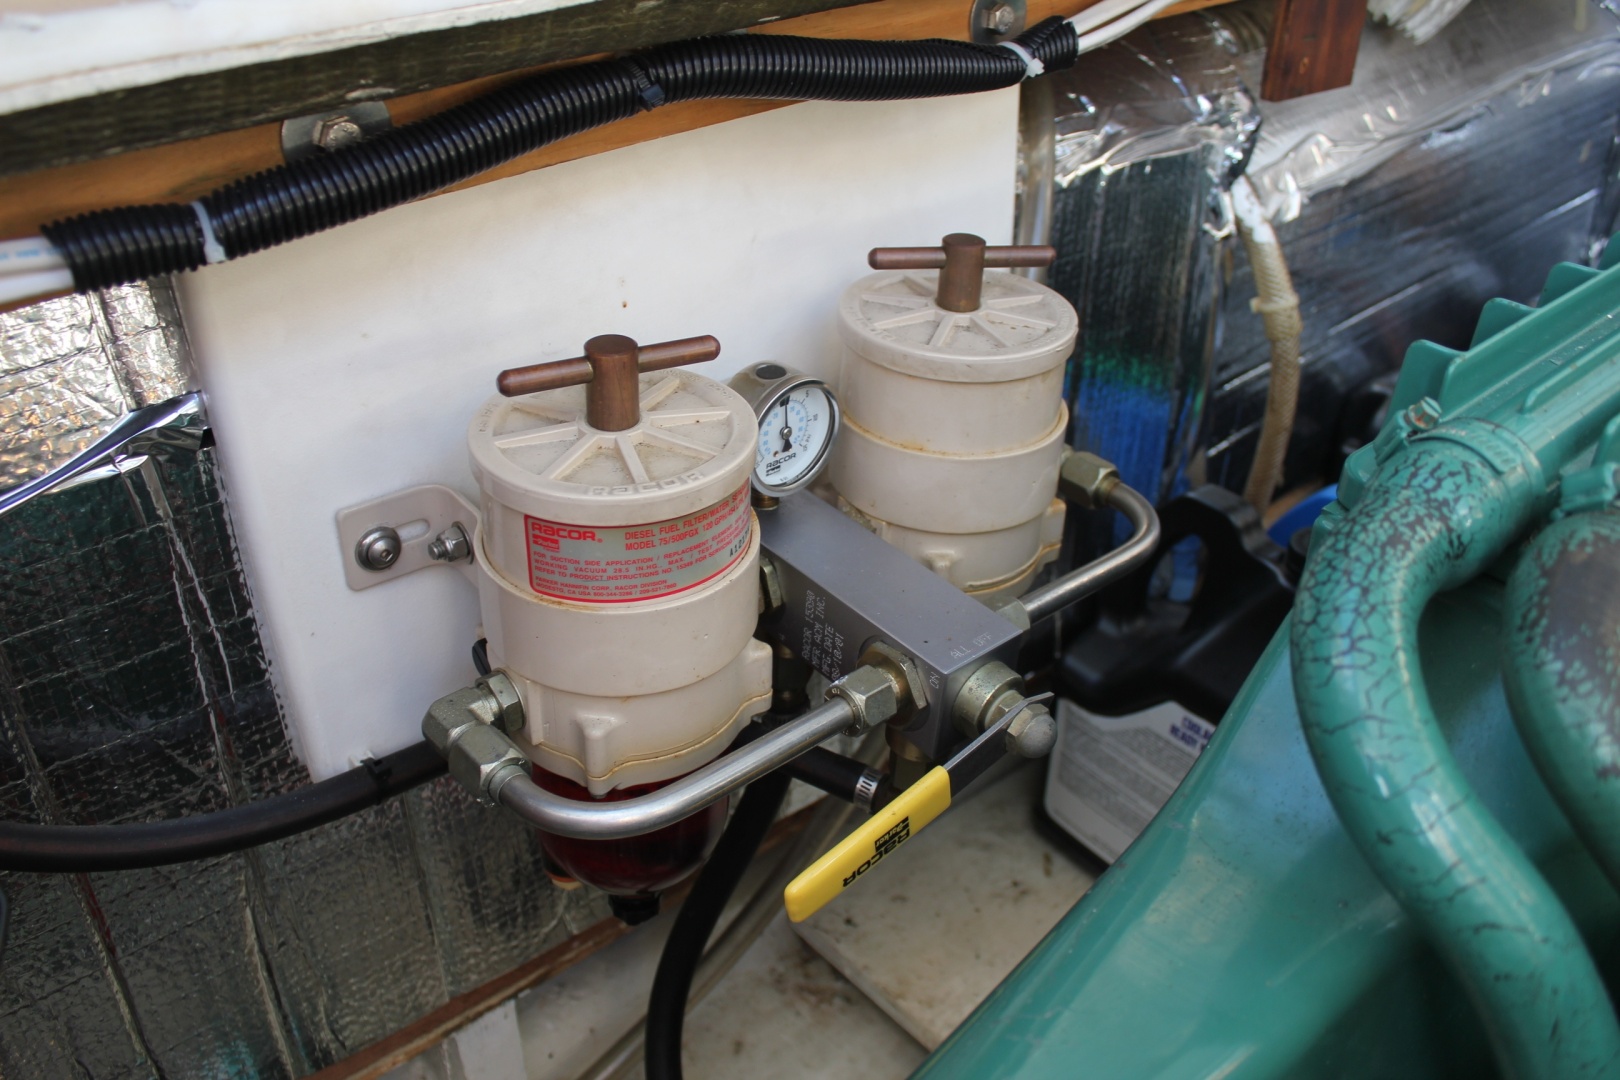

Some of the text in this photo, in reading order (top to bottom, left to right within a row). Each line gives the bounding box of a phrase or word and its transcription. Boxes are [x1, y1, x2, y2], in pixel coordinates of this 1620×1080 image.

[624, 529, 656, 540] DIESEL
[659, 524, 680, 535] FUEL
[683, 500, 730, 529] FILTER/WATER
[625, 540, 656, 551] MODEL
[658, 526, 699, 546] 75/500FGX
[533, 550, 546, 559] FOR
[550, 555, 580, 565] SUCTION
[605, 557, 653, 566] APPLICATION
[664, 540, 709, 559] REPLACEMENT
[534, 558, 568, 571] WORKING
[574, 566, 607, 574] VACUUM
[698, 545, 713, 556] TEST
[534, 566, 556, 575] REFER
[558, 570, 567, 578] TO
[570, 572, 604, 581] PRODUCT
[606, 569, 660, 581] INSTRUCTIONS
[694, 554, 707, 564] FOR
[535, 576, 558, 586] PARKER
[560, 582, 590, 590] HANNIFIN
[640, 580, 668, 588] DIVISION
[816, 596, 826, 619] INC.
[802, 627, 812, 661] RACOR
[824, 622, 834, 652] DATE
